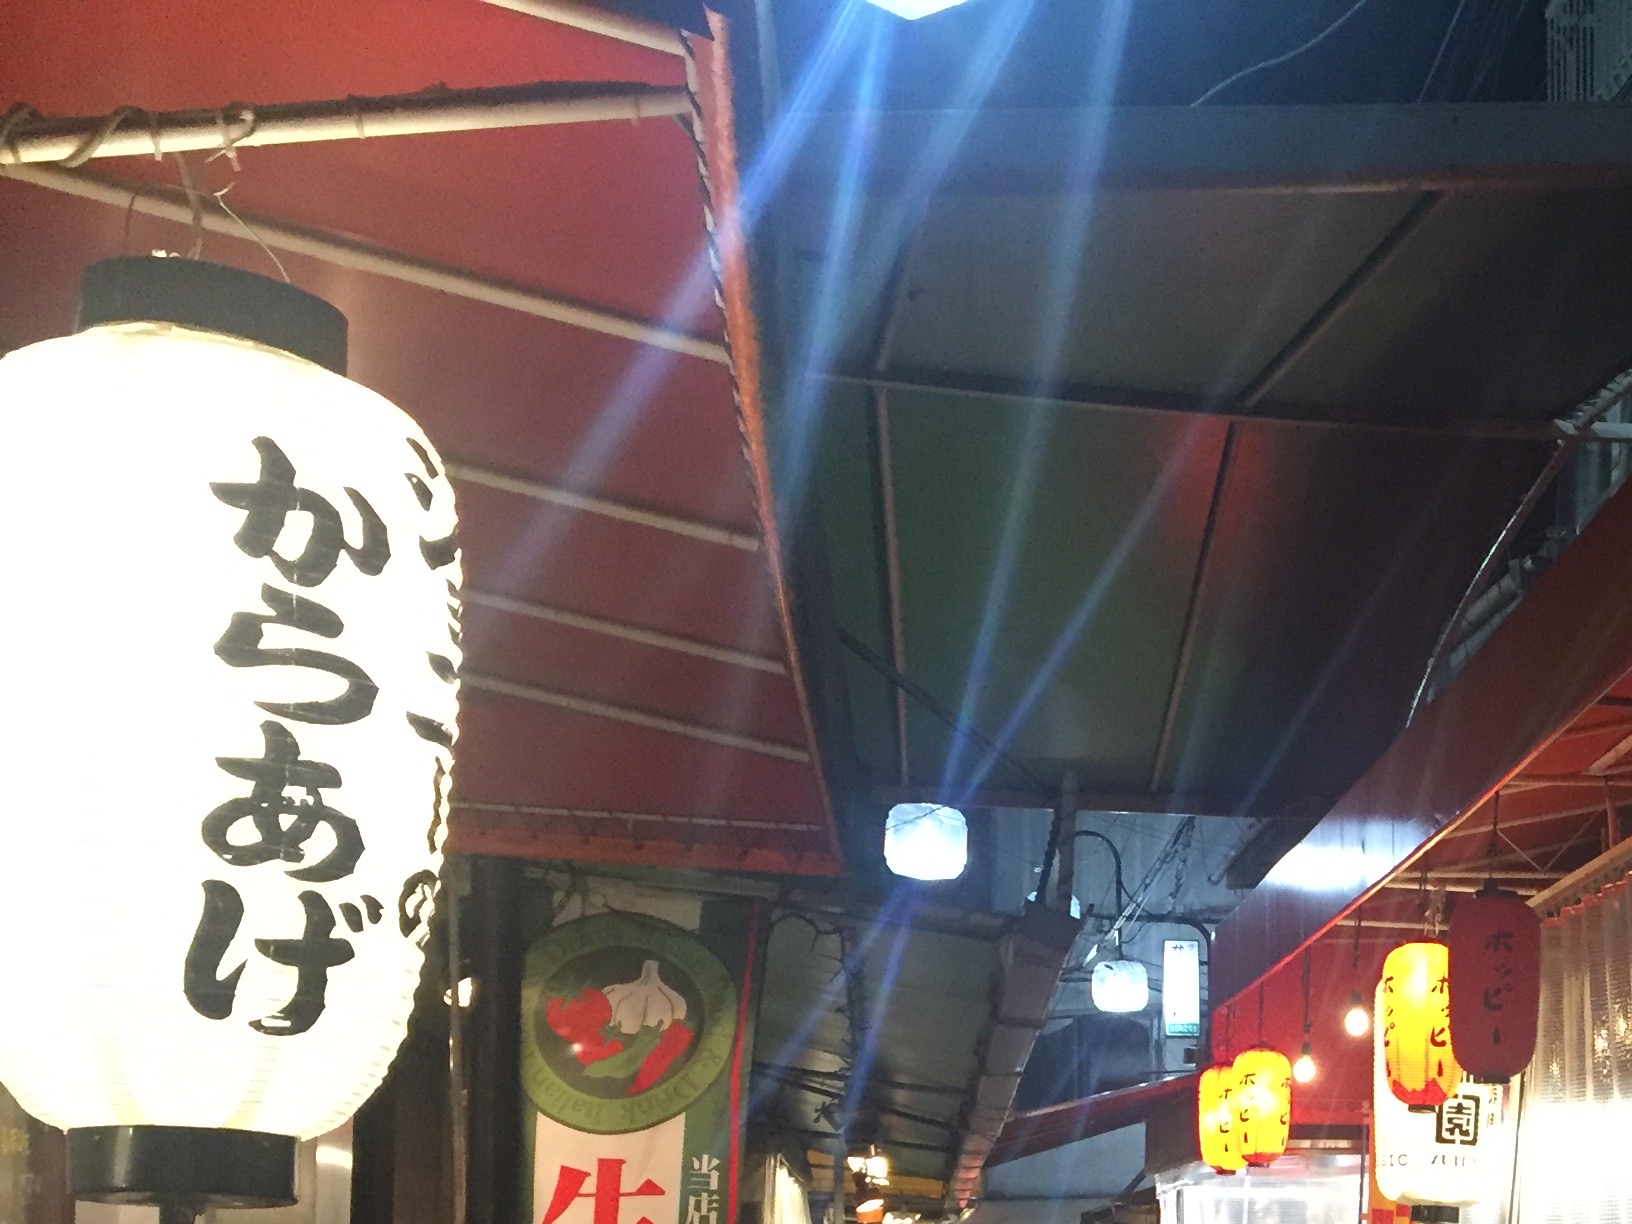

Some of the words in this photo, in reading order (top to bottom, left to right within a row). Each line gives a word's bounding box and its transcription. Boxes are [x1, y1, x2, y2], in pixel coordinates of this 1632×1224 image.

[183, 435, 392, 1036] からあげ
[1484, 929, 1514, 1046] ホッピー
